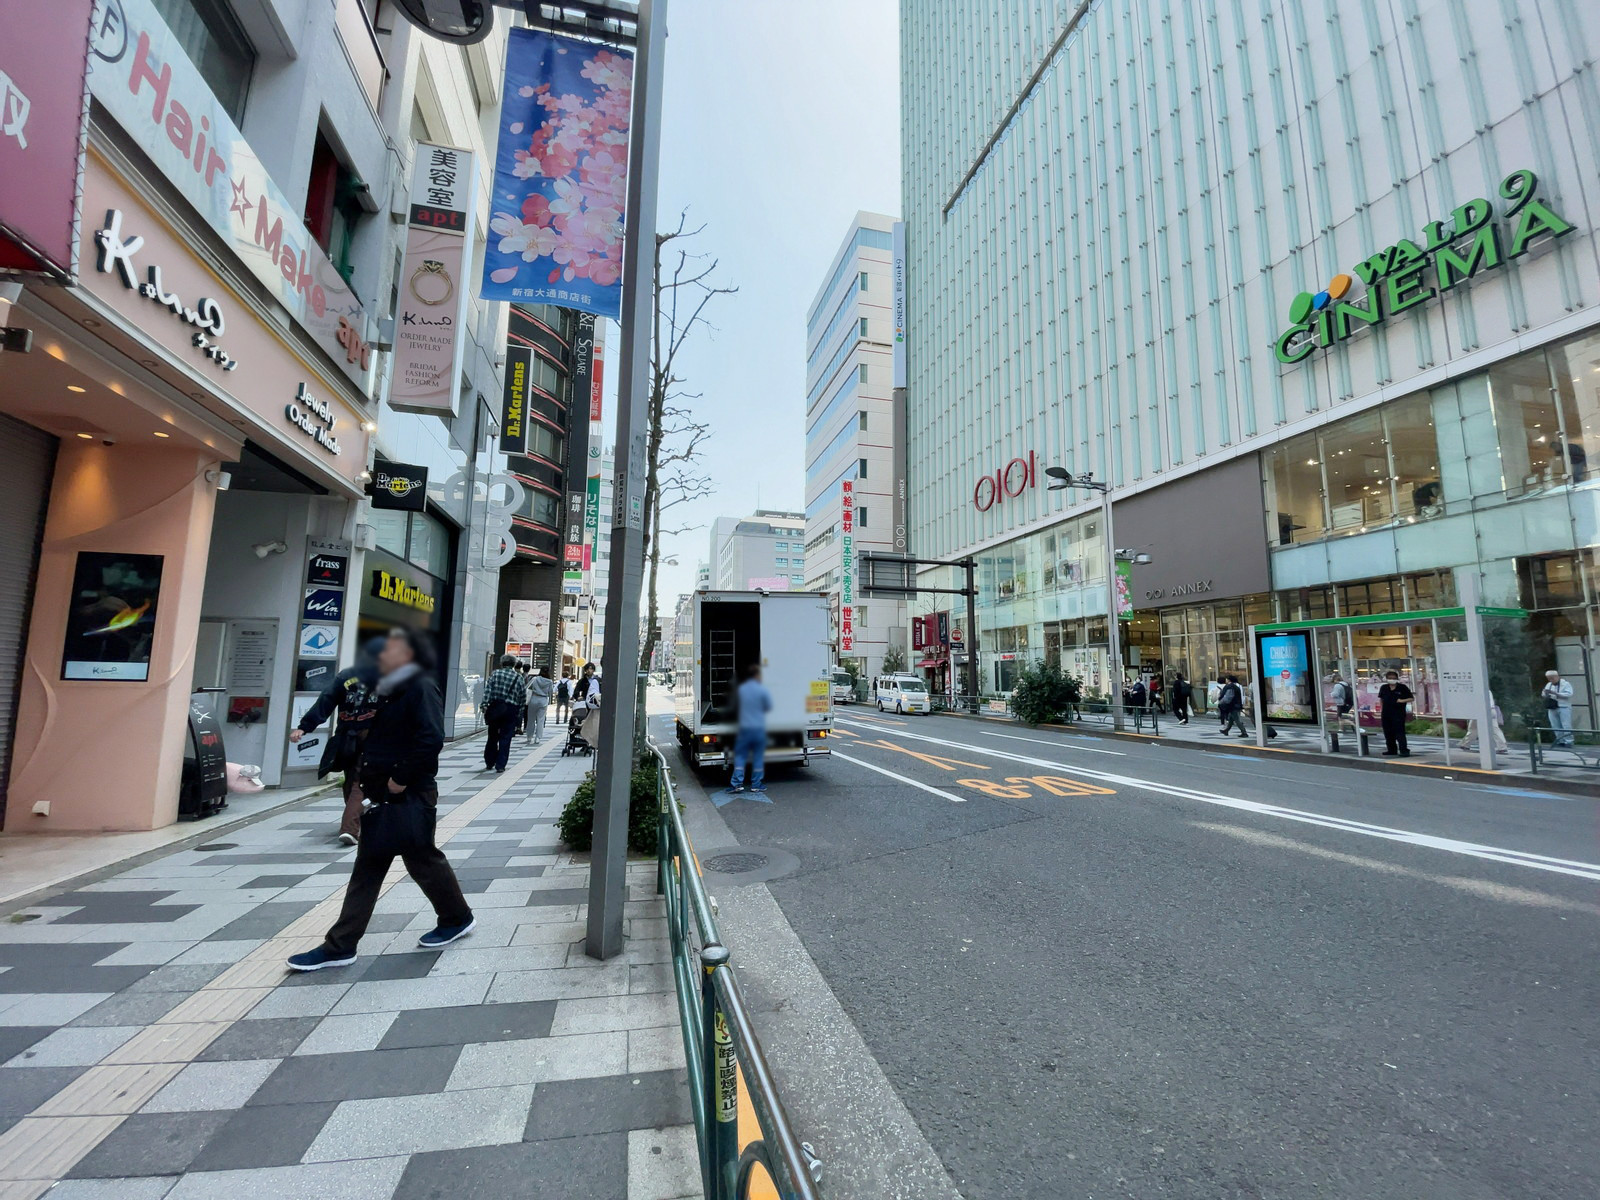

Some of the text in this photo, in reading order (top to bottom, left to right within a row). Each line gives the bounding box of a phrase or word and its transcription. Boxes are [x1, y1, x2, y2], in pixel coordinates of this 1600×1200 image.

[129, 30, 327, 318] Hair Make
[427, 149, 458, 208] 美容室
[417, 209, 459, 226] apt
[1353, 169, 1539, 285] WALD 9
[1275, 198, 1578, 364] CINEMA
[511, 287, 592, 305] 新宿大通商店街
[579, 310, 595, 332] &E
[400, 332, 453, 345] ORDER MADE
[409, 342, 442, 352] JEWELRY
[405, 369, 440, 379] FASHION
[409, 362, 438, 372] BRIDAL
[405, 378, 440, 388] REFORM
[296, 382, 338, 431] Jewelry
[286, 404, 342, 456] Order Made
[376, 478, 423, 490] Martens
[315, 557, 340, 570] trass
[842, 536, 852, 604] 日本一安く売る店
[1171, 580, 1213, 597] ANNEX
[841, 606, 853, 651] 世界堂
